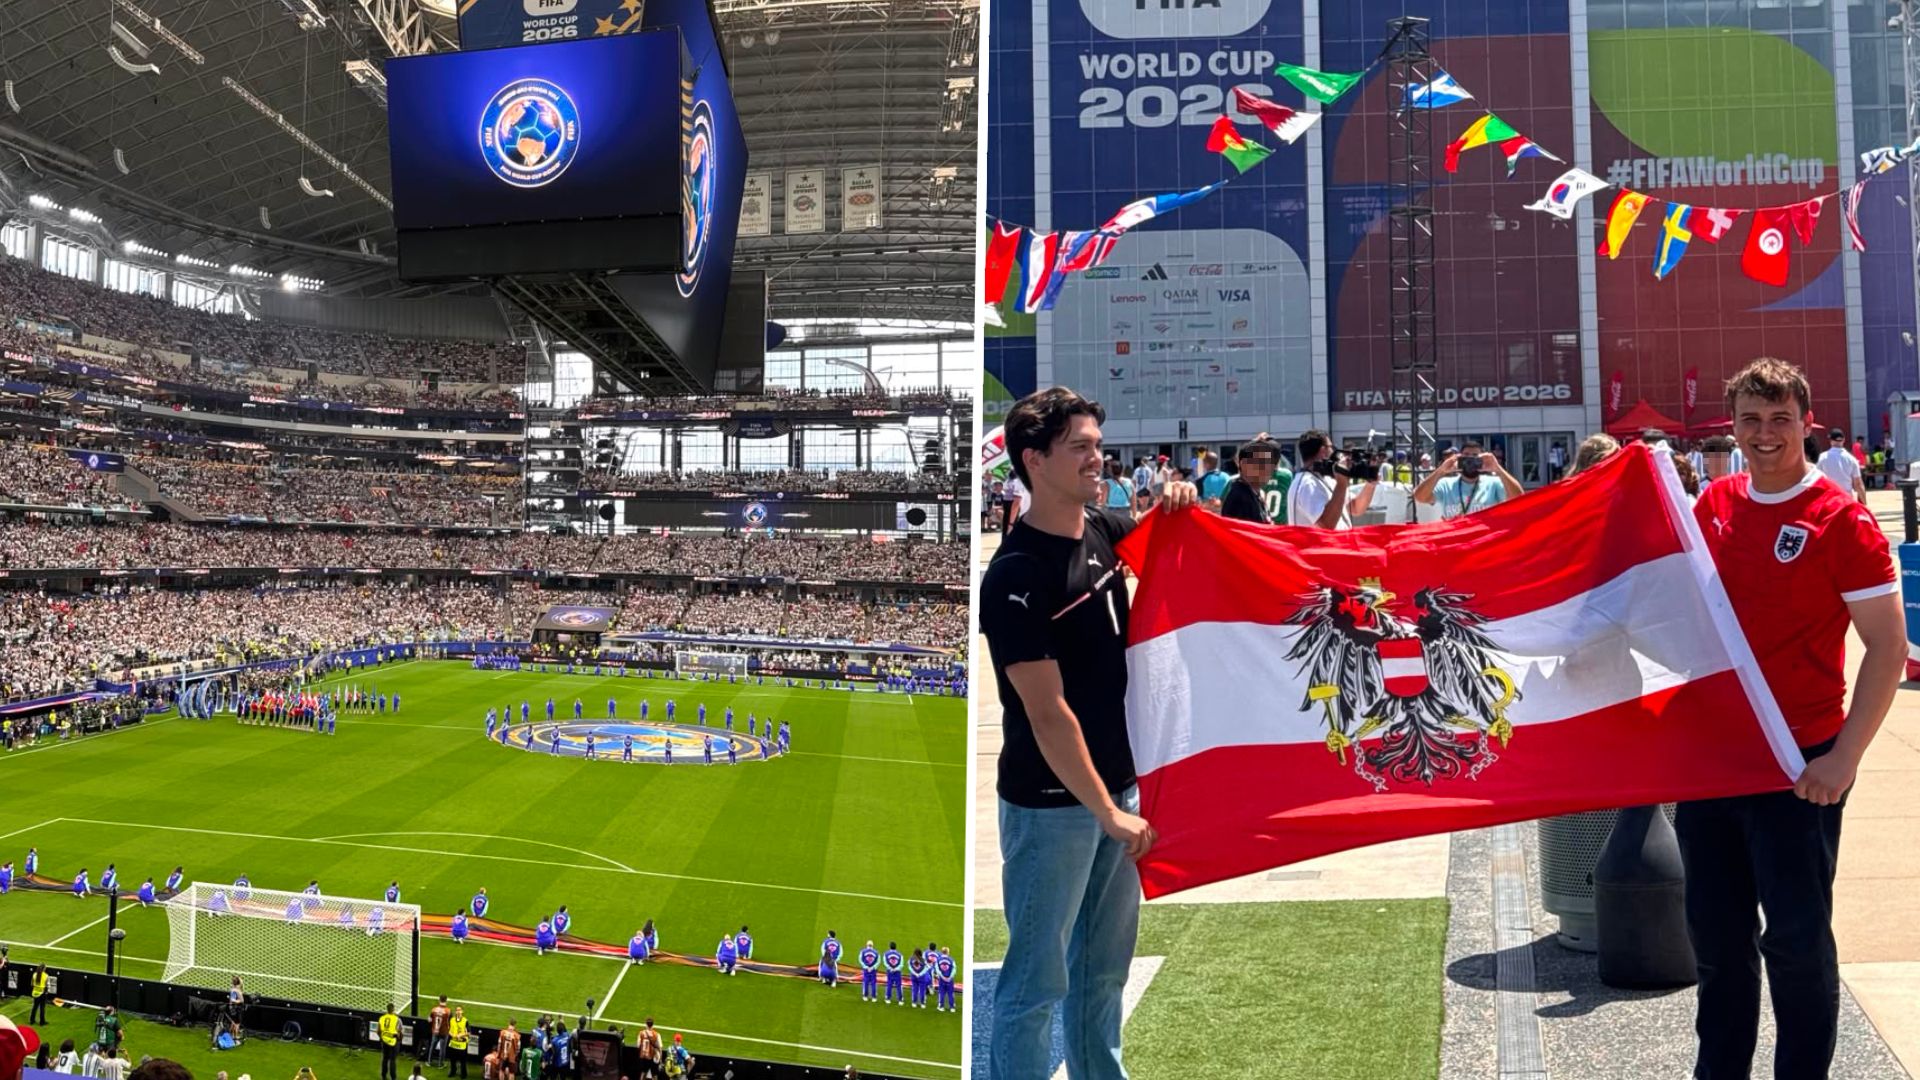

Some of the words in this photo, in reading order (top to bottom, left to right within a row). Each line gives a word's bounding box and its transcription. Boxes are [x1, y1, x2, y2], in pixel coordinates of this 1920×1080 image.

[523, 18, 558, 29] WORLD
[559, 15, 578, 24] CUP
[522, 25, 578, 42] 2026
[1079, 52, 1202, 79] WORLD
[1208, 50, 1275, 76] CUP
[1079, 83, 1273, 128] 2026
[1607, 153, 1825, 189] #FIFAWorldCup
[1110, 294, 1147, 303] Lenovo
[1163, 289, 1199, 300] QATAR
[1218, 289, 1251, 301] VISA
[1344, 390, 1385, 406] FIFA
[1388, 388, 1458, 405] WRLD
[1461, 387, 1499, 402] CUP
[1503, 384, 1572, 400] 2026
[1179, 420, 1188, 440] H
